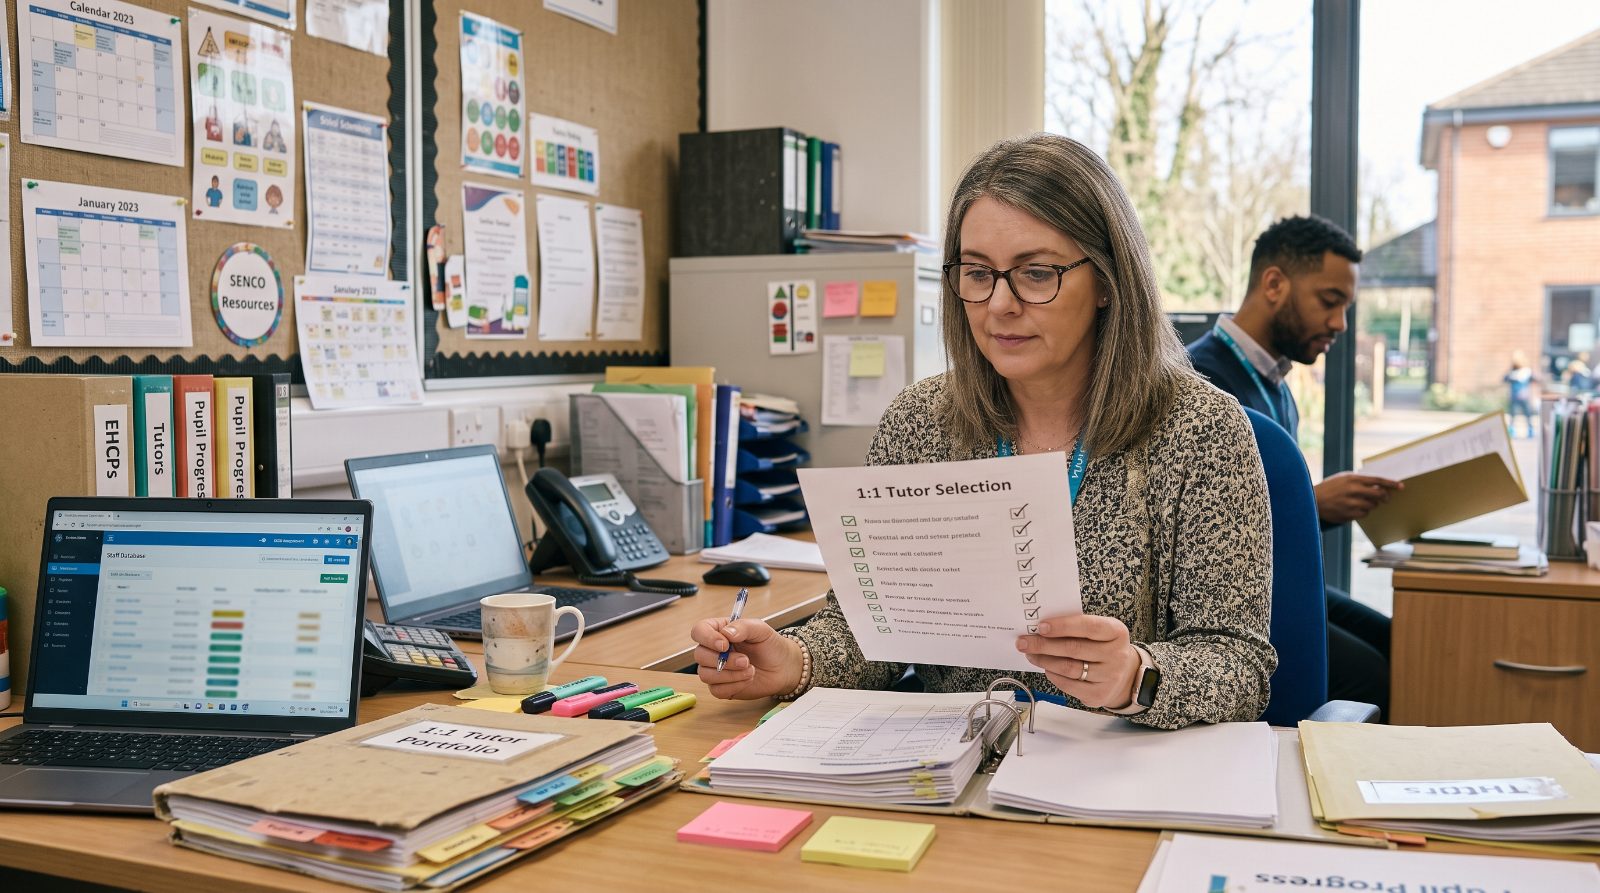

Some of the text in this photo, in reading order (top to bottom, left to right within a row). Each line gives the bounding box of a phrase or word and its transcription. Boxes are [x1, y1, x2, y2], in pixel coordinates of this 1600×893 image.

[70, 0, 134, 25] Calendar 2023
[78, 196, 139, 212] January 2023
[230, 274, 266, 289] SENCO
[222, 296, 274, 311] Resources
[193, 400, 206, 438] Pupil
[233, 396, 246, 435] Pupil
[153, 422, 165, 475] Tutors
[857, 480, 1012, 499] 1:1 Tutor Selection
[419, 726, 528, 744] 1:1 Tutor
[1253, 873, 1406, 893] Progress
